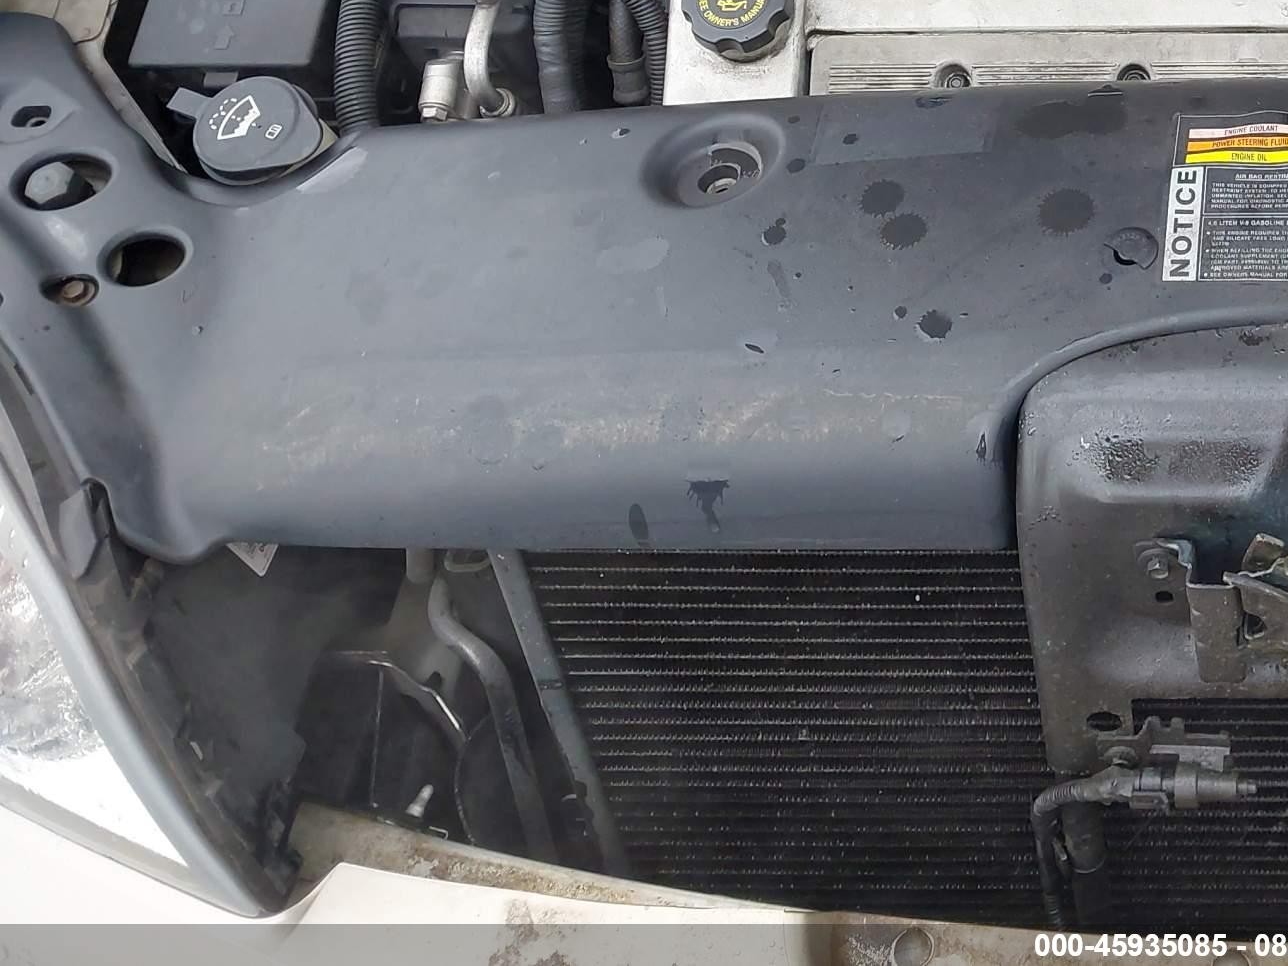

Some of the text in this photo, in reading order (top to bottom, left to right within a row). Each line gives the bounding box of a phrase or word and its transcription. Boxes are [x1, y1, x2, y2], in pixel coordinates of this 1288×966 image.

[704, 10, 740, 27] OWNER'S
[1224, 125, 1279, 136] ENGINE COOLANT
[1211, 139, 1236, 148] POWER
[1237, 139, 1269, 147] STEERING
[1231, 152, 1268, 161] ENGINE OIL
[1169, 170, 1198, 277] NOTICE
